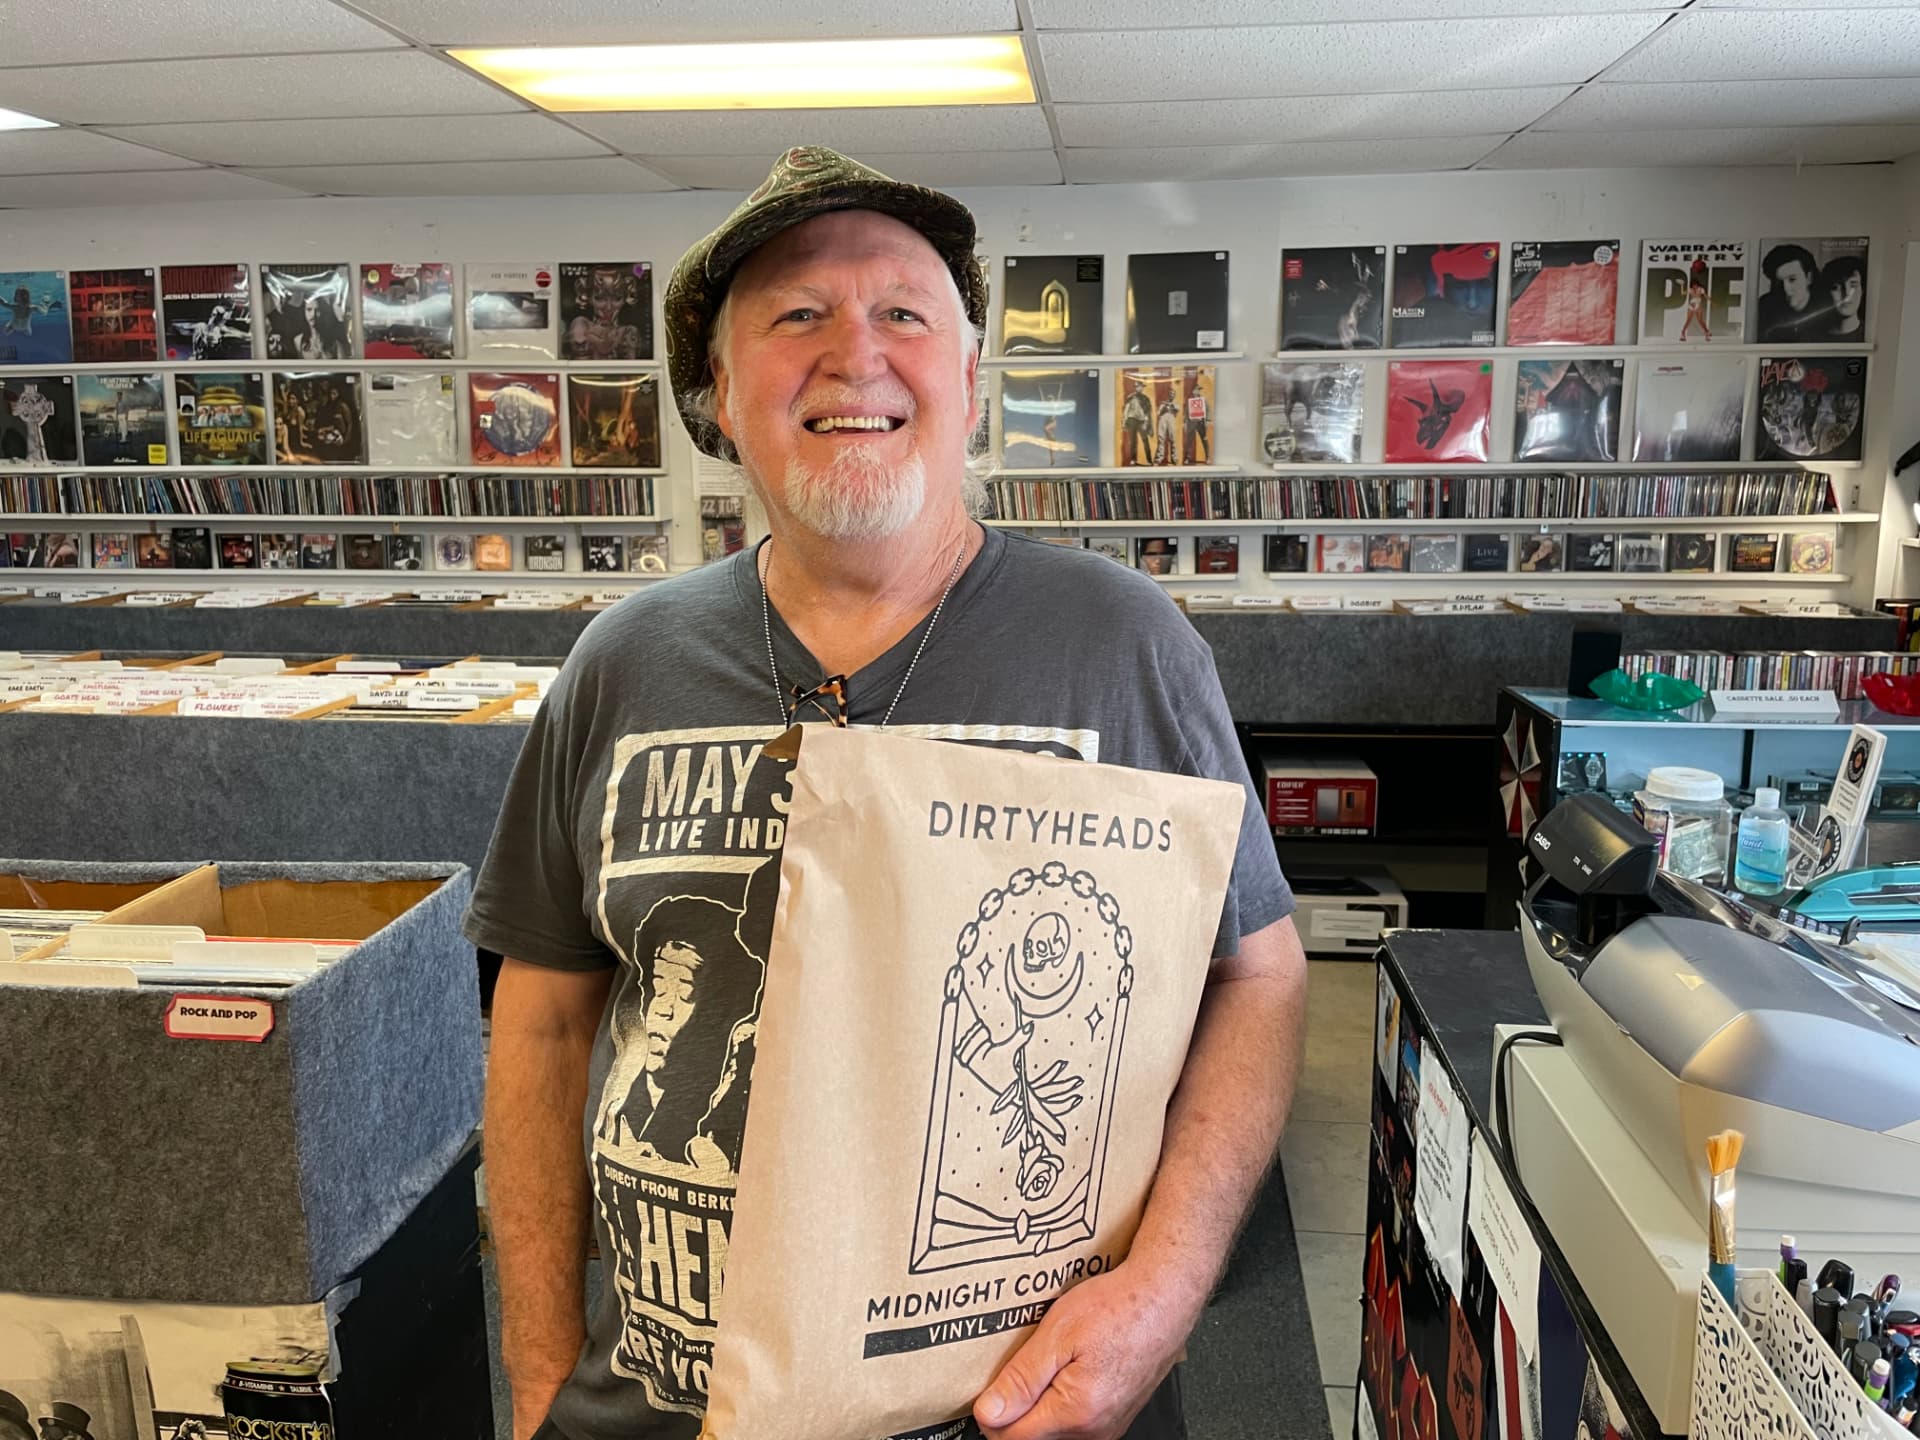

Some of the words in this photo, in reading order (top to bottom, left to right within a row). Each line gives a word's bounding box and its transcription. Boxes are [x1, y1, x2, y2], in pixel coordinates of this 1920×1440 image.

[1648, 253, 1744, 262] CHERRY
[1645, 266, 1744, 337] PIE
[184, 431, 206, 443] LIFE
[208, 431, 261, 442] AQUATIC
[702, 500, 715, 513] ZZ
[1476, 548, 1499, 557] LIVE
[194, 703, 240, 712] FLOWERS
[641, 744, 765, 818] MAY
[1276, 781, 1304, 789] EDIFIER
[928, 800, 1171, 852] DIRTYHEADS
[639, 818, 706, 853] LIVE
[724, 817, 785, 850] IND
[1534, 832, 1551, 850] CASIO
[180, 1006, 209, 1017] ROCK
[211, 1008, 233, 1019] AND
[235, 1010, 258, 1020] POP
[604, 1164, 638, 1190] DIRECT
[640, 1179, 679, 1202] FROM
[867, 1277, 1007, 1322] MIDNIGHT
[1014, 1254, 1113, 1297] CONTROL
[928, 1317, 989, 1344] VINYL
[996, 1303, 1046, 1330] JUNE
[686, 1344, 707, 1354] and
